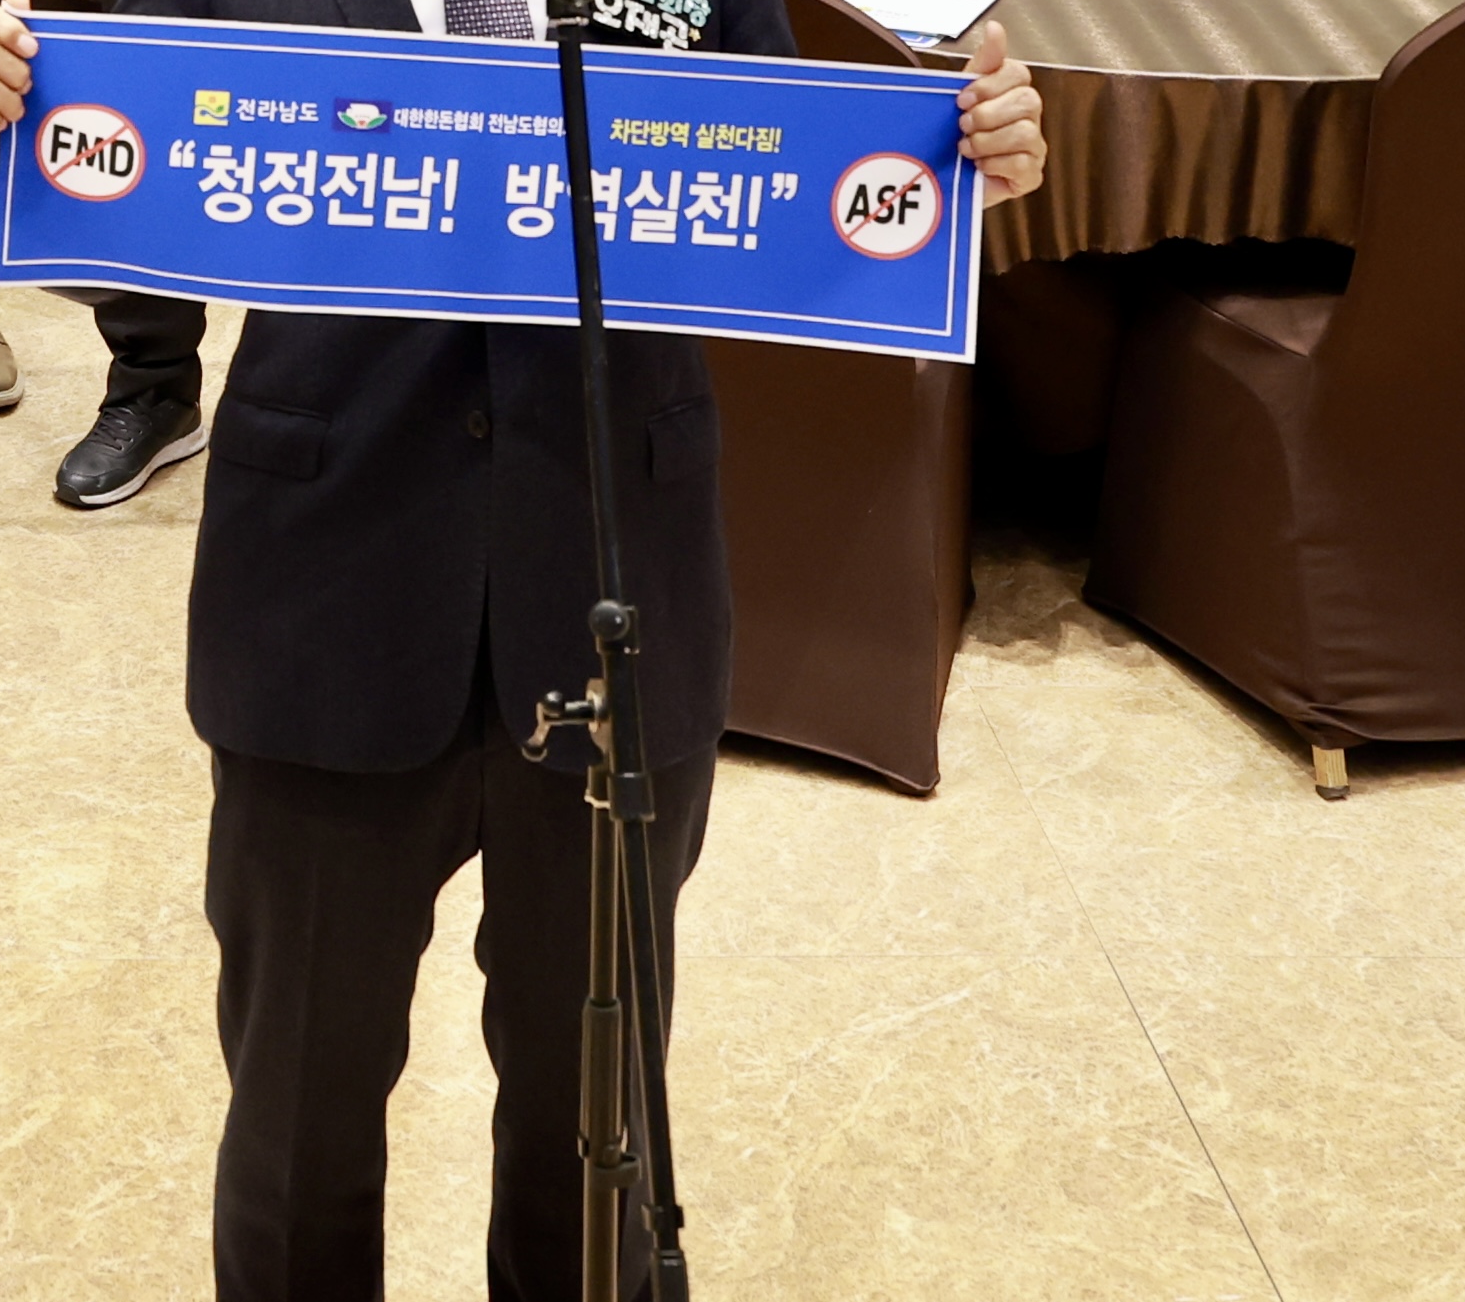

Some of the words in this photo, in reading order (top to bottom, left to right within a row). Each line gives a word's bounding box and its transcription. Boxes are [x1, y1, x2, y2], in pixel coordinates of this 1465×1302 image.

[235, 98, 319, 124] 전라남도
[393, 107, 485, 133] 대한한돈협회
[487, 113, 566, 137] 전남도협의
[50, 124, 134, 177] FMD
[609, 118, 690, 148] 차단방역
[695, 123, 782, 154] 실천다짐!
[168, 139, 459, 233] “청정전남!
[845, 183, 921, 225] ASF
